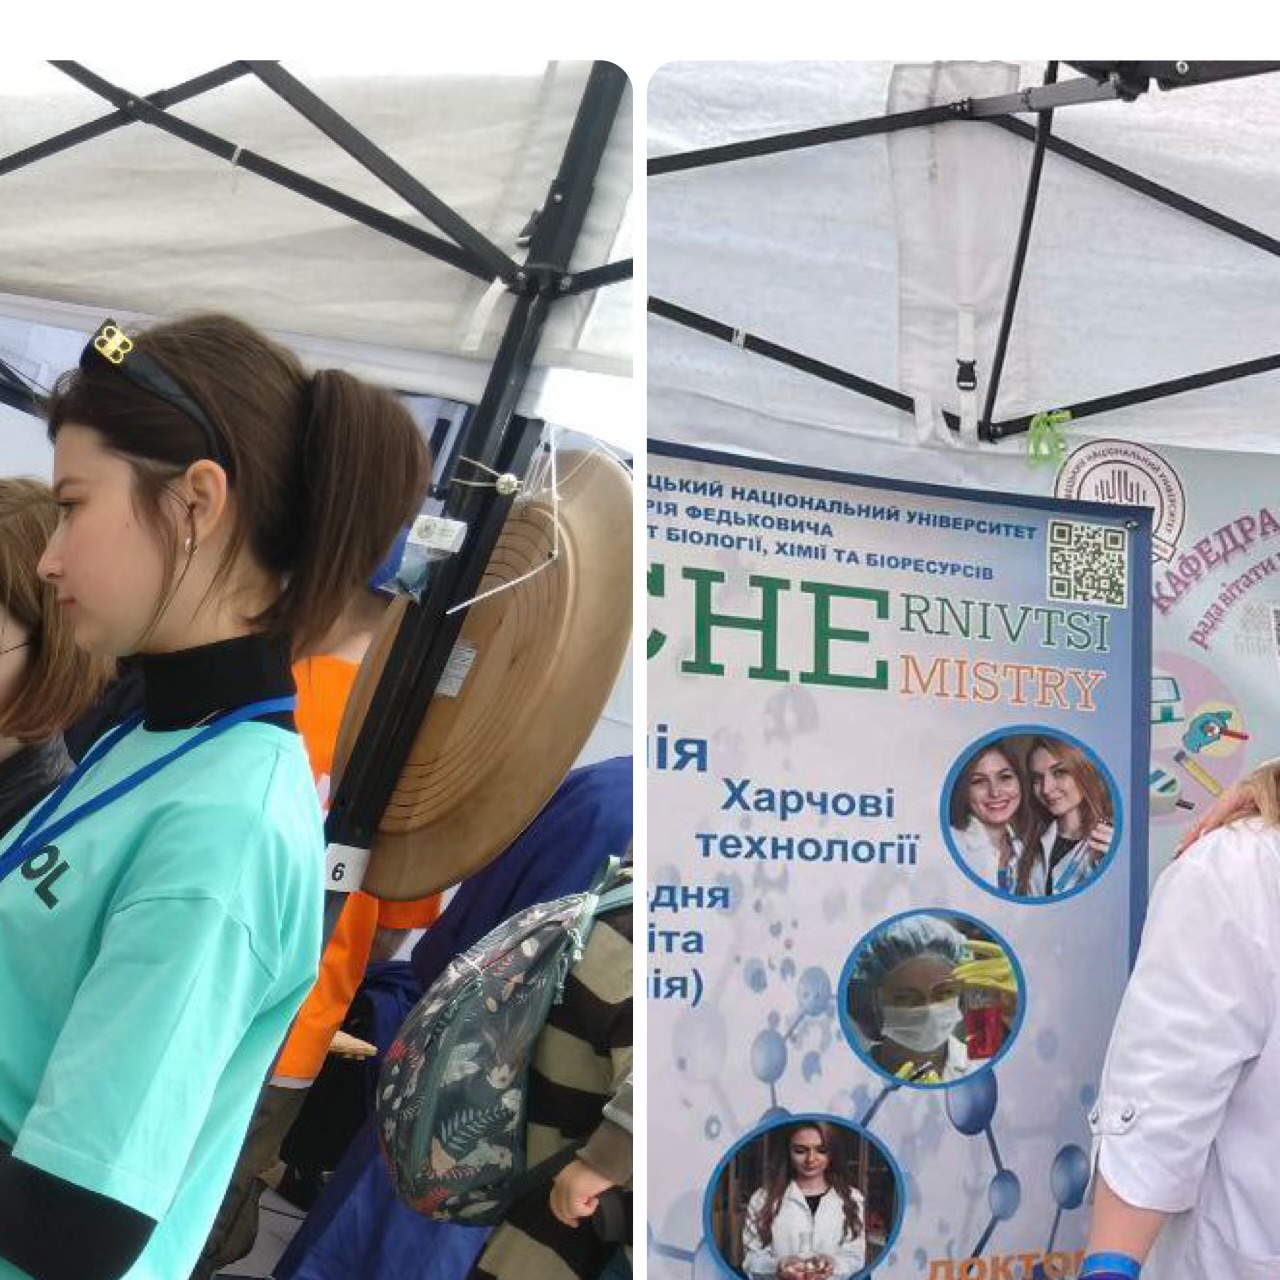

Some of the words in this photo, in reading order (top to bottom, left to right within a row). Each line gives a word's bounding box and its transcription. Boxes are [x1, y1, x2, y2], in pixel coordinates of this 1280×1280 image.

[685, 501, 834, 538] ФЕДЬКОВИЧА
[731, 486, 900, 521] НАЦІОНАЛЬНИЙ
[906, 511, 1038, 540] УНІВЕРСИТЕТ
[667, 526, 768, 556] БІОЛОГІЇ,
[775, 541, 827, 562] ХІМІЇ
[833, 547, 860, 565] ТА
[866, 552, 994, 581] БІОРЕСУРСІВ
[900, 592, 1110, 653] RNIVTSI
[1189, 602, 1224, 649] рада
[1219, 558, 1280, 604] вітати
[900, 654, 1106, 711] MISTRY
[721, 777, 895, 821] Харчові
[331, 863, 346, 882] 6
[695, 830, 920, 866] технології
